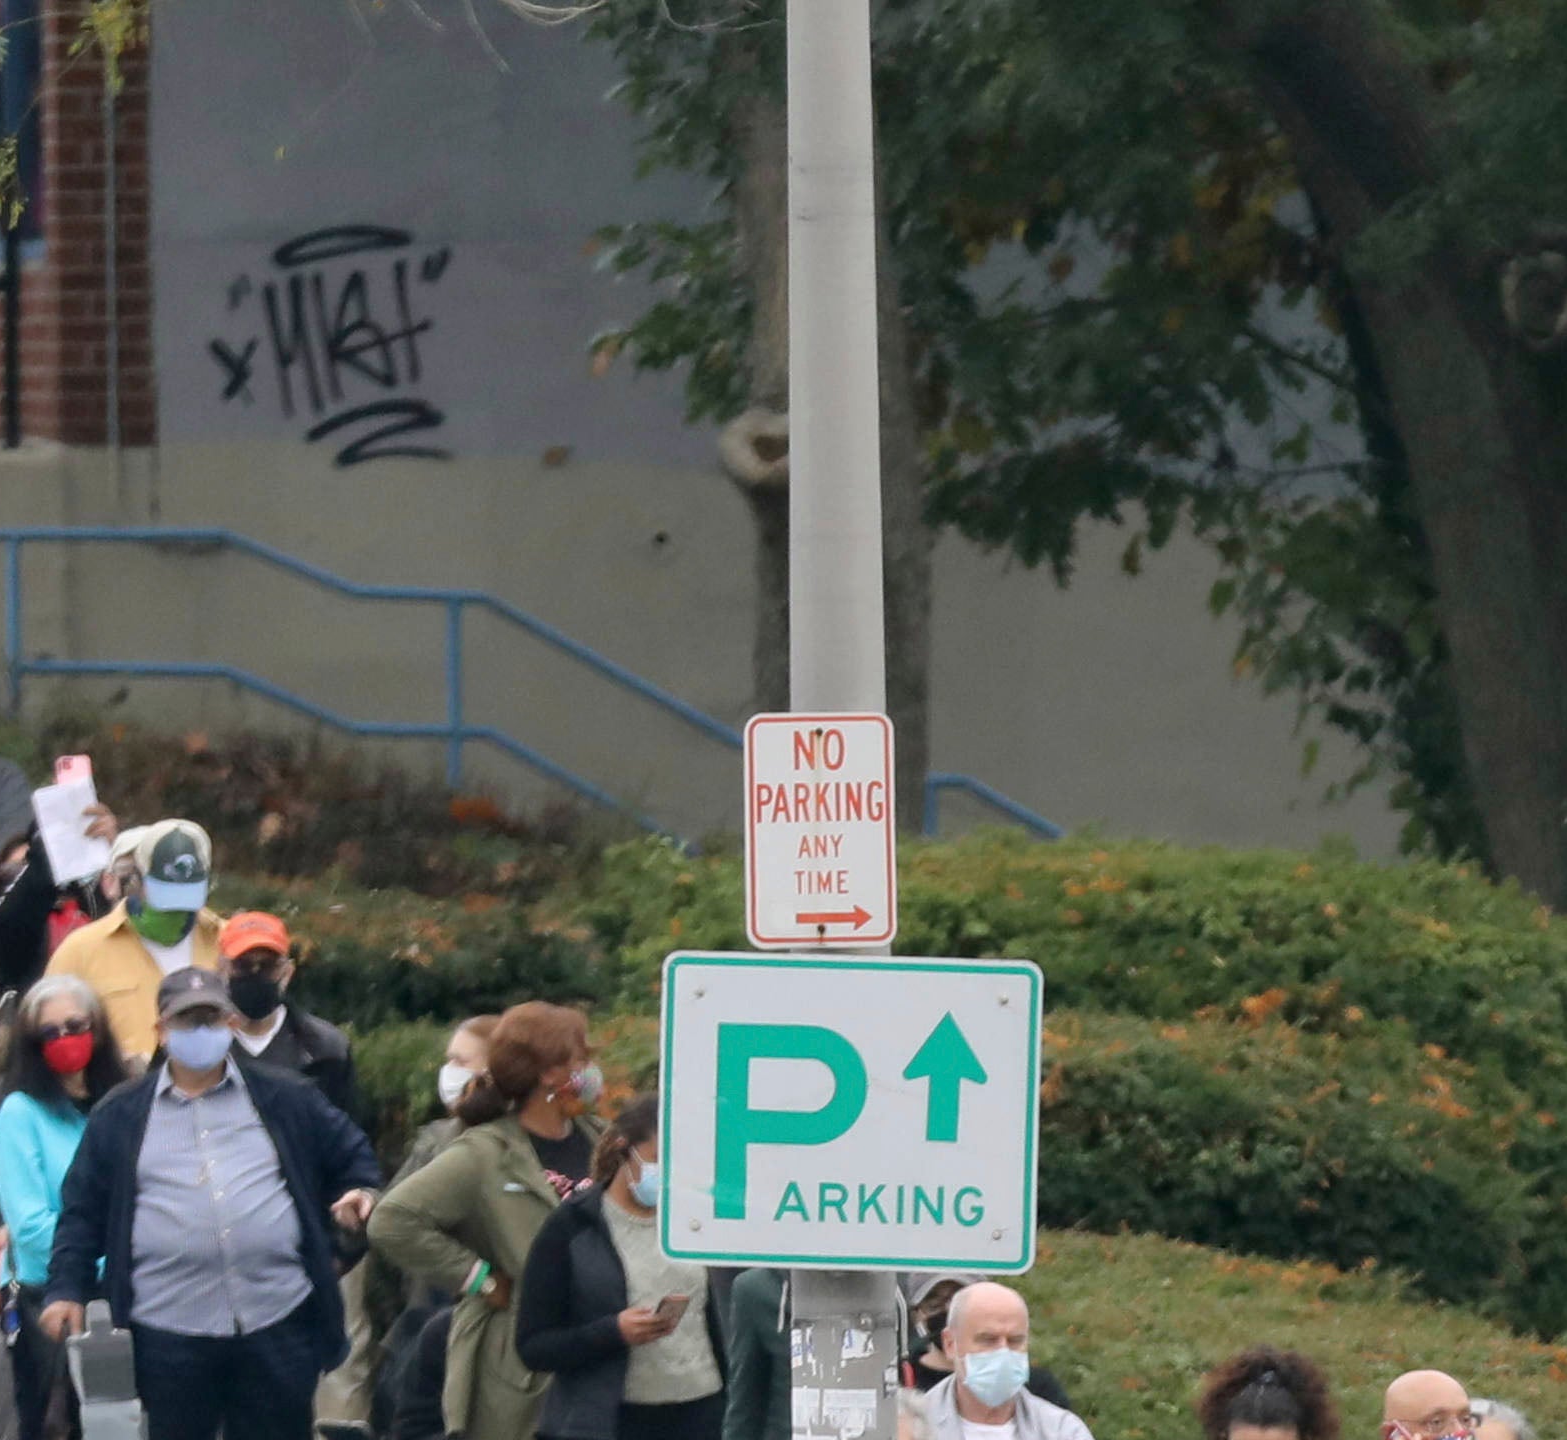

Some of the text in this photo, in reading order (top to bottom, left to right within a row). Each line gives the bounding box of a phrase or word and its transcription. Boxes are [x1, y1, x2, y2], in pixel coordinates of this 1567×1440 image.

[794, 729, 844, 771] NO
[757, 781, 884, 824] PARKING
[799, 834, 843, 859] ANY
[794, 869, 849, 895] TIME
